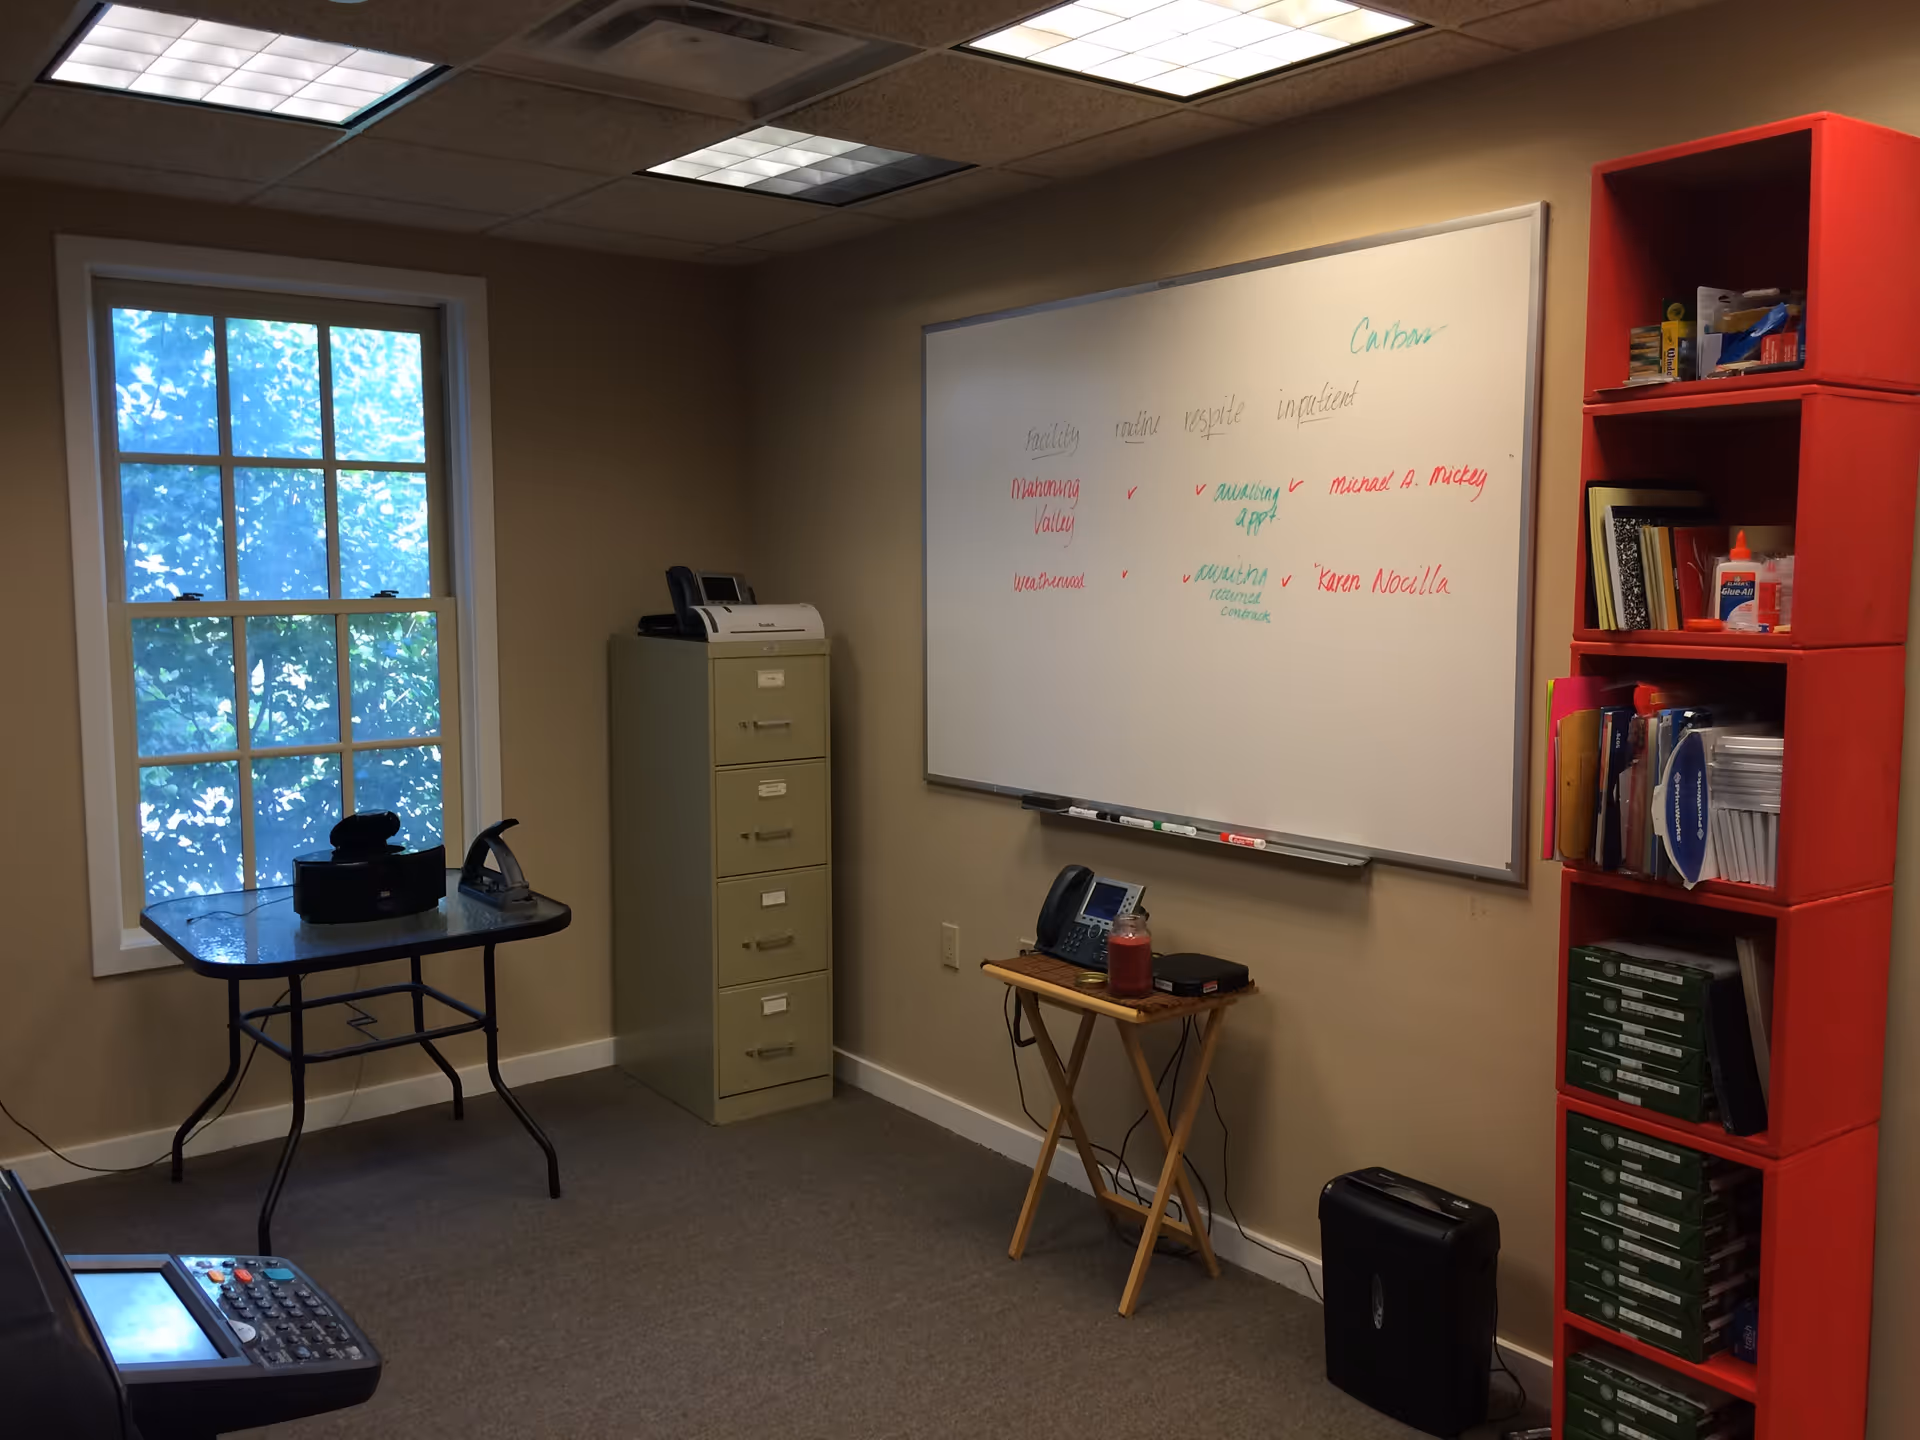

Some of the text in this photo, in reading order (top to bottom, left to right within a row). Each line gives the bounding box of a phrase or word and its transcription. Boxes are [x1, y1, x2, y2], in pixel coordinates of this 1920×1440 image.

[1184, 394, 1245, 440] respite
[1277, 380, 1359, 429] inpatient
[1329, 464, 1488, 502] Michael A. Mickey
[1034, 503, 1075, 548] Valley
[1317, 565, 1361, 593] Karen
[1720, 587, 1754, 597] Glue-All
